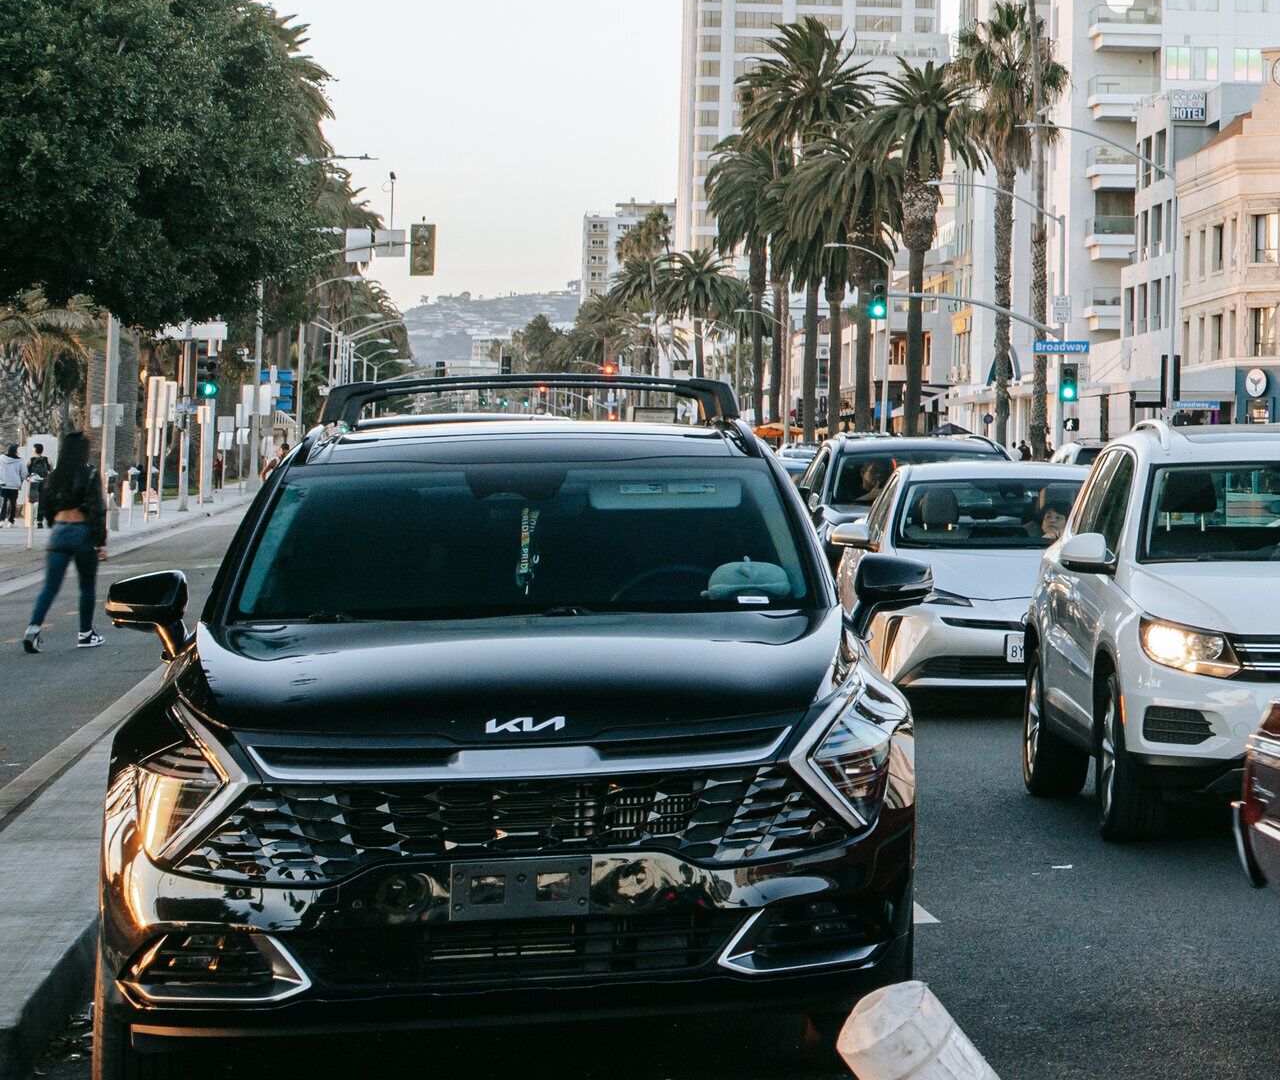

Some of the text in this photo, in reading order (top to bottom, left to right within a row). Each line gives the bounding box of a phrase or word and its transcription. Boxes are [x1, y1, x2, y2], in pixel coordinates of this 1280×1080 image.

[1173, 93, 1204, 101] OCEAN
[1172, 107, 1204, 119] HOTEL
[1035, 342, 1087, 352] Broadway
[485, 716, 565, 733] KIA
